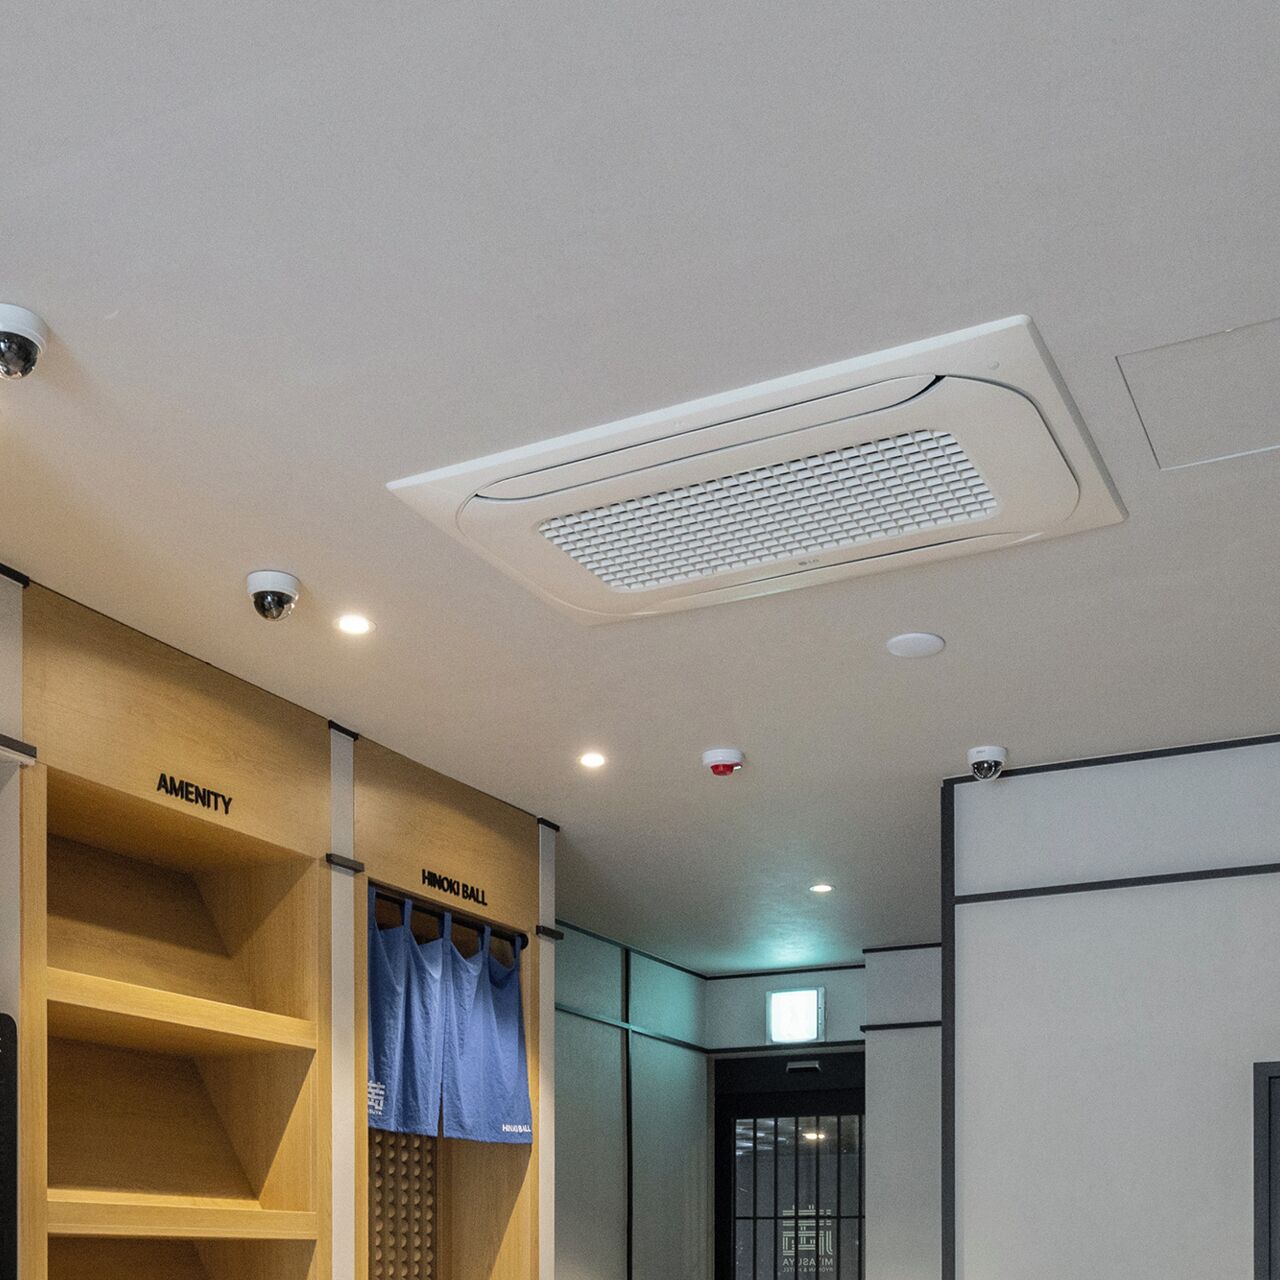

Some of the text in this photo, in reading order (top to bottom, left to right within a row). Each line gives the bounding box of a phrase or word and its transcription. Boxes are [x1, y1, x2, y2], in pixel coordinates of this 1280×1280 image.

[156, 773, 232, 815] AMENITY
[422, 868, 488, 906] HINOKI BALL
